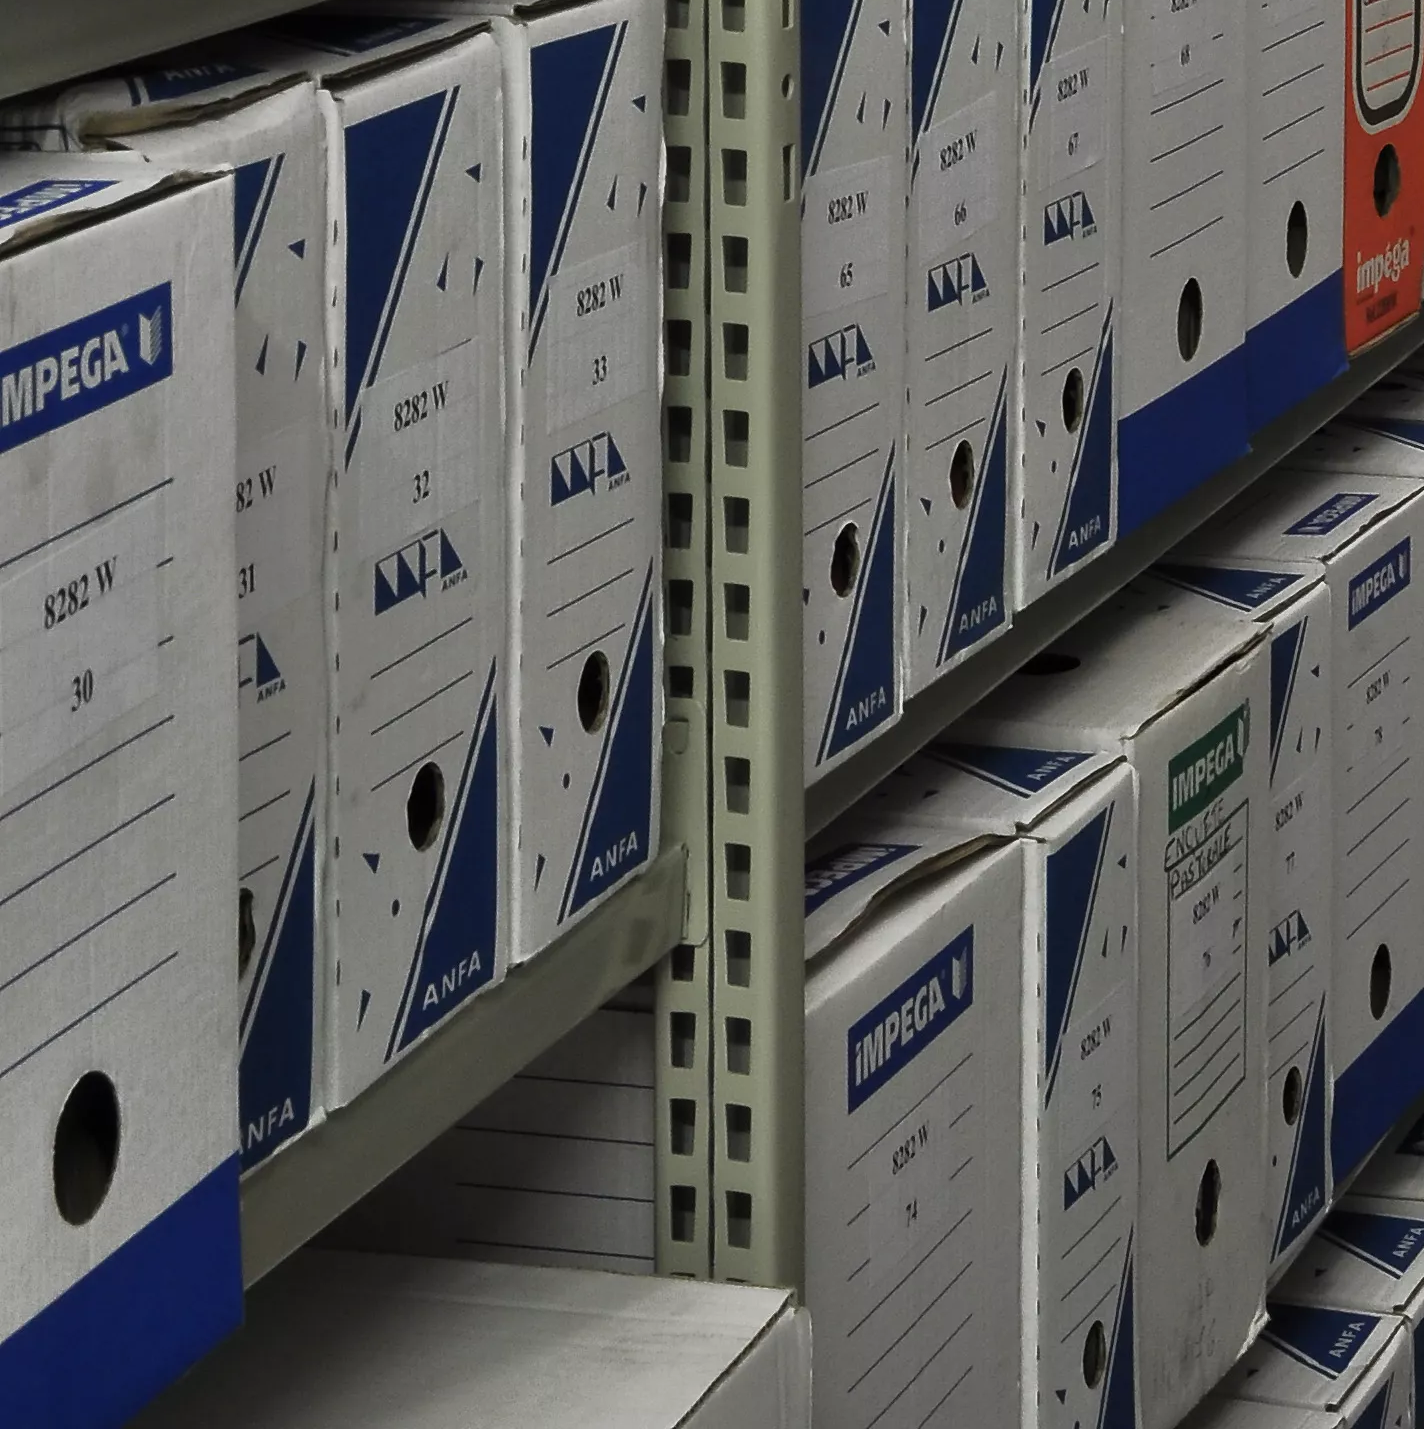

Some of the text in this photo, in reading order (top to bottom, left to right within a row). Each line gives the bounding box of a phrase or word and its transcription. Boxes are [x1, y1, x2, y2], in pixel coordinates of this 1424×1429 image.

[1181, 45, 1190, 66] 68
[1056, 68, 1089, 102] 8282 W
[939, 130, 977, 171] 8282 W
[1067, 132, 1078, 155] 67
[828, 191, 868, 225] 8282 W
[954, 200, 967, 225] 66
[840, 262, 853, 288] 65
[577, 275, 623, 317] 8282 W
[592, 357, 607, 385] 33
[395, 381, 448, 432] 8282 W
[258, 467, 276, 497] W
[413, 471, 430, 503] 32
[608, 472, 630, 491] ANFA
[1068, 519, 1101, 549] ANFA
[45, 558, 116, 630] 8282 W
[239, 562, 255, 598] 31
[442, 569, 467, 592] ANFA
[959, 601, 997, 634] ANFA
[72, 667, 93, 711] 30
[257, 680, 286, 702] ANFA
[846, 686, 886, 731] ANFA
[1027, 754, 1076, 781] ANFA
[1276, 805, 1292, 830] 8282
[590, 831, 639, 882] ANFA
[422, 950, 483, 1010] ANFA
[1080, 1016, 1111, 1059] 8282 W
[892, 1122, 929, 1175] 8282 W
[905, 1201, 918, 1226] 74
[1292, 1190, 1321, 1228] ANFA
[1393, 1225, 1424, 1258] ANFA
[1329, 1321, 1365, 1359] ANFA
